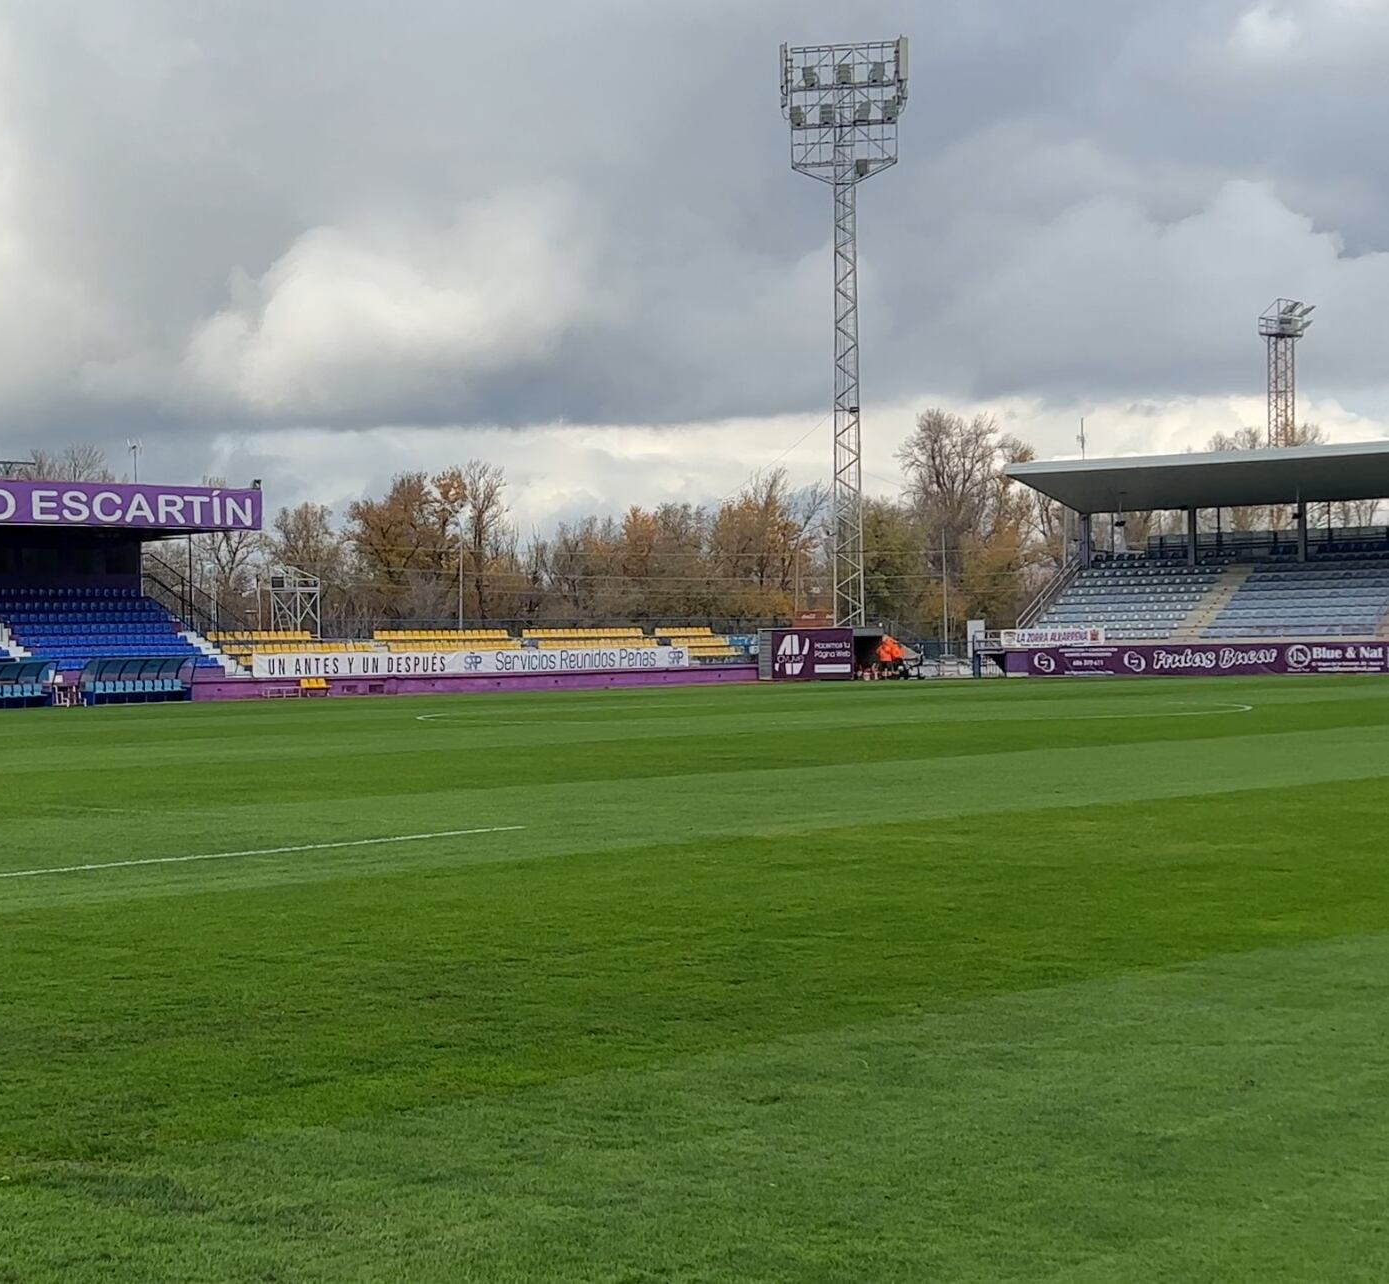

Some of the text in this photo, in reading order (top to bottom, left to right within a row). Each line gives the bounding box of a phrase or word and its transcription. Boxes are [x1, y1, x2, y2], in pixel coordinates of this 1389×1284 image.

[32, 490, 252, 526] ESCARTÍN
[495, 648, 656, 671] Servicios Reunidos Peñas
[1153, 649, 1216, 669] Frutas
[1312, 646, 1383, 659] Blue & Nat
[268, 653, 446, 675] UN ANTES Y UN DESPUÉS
